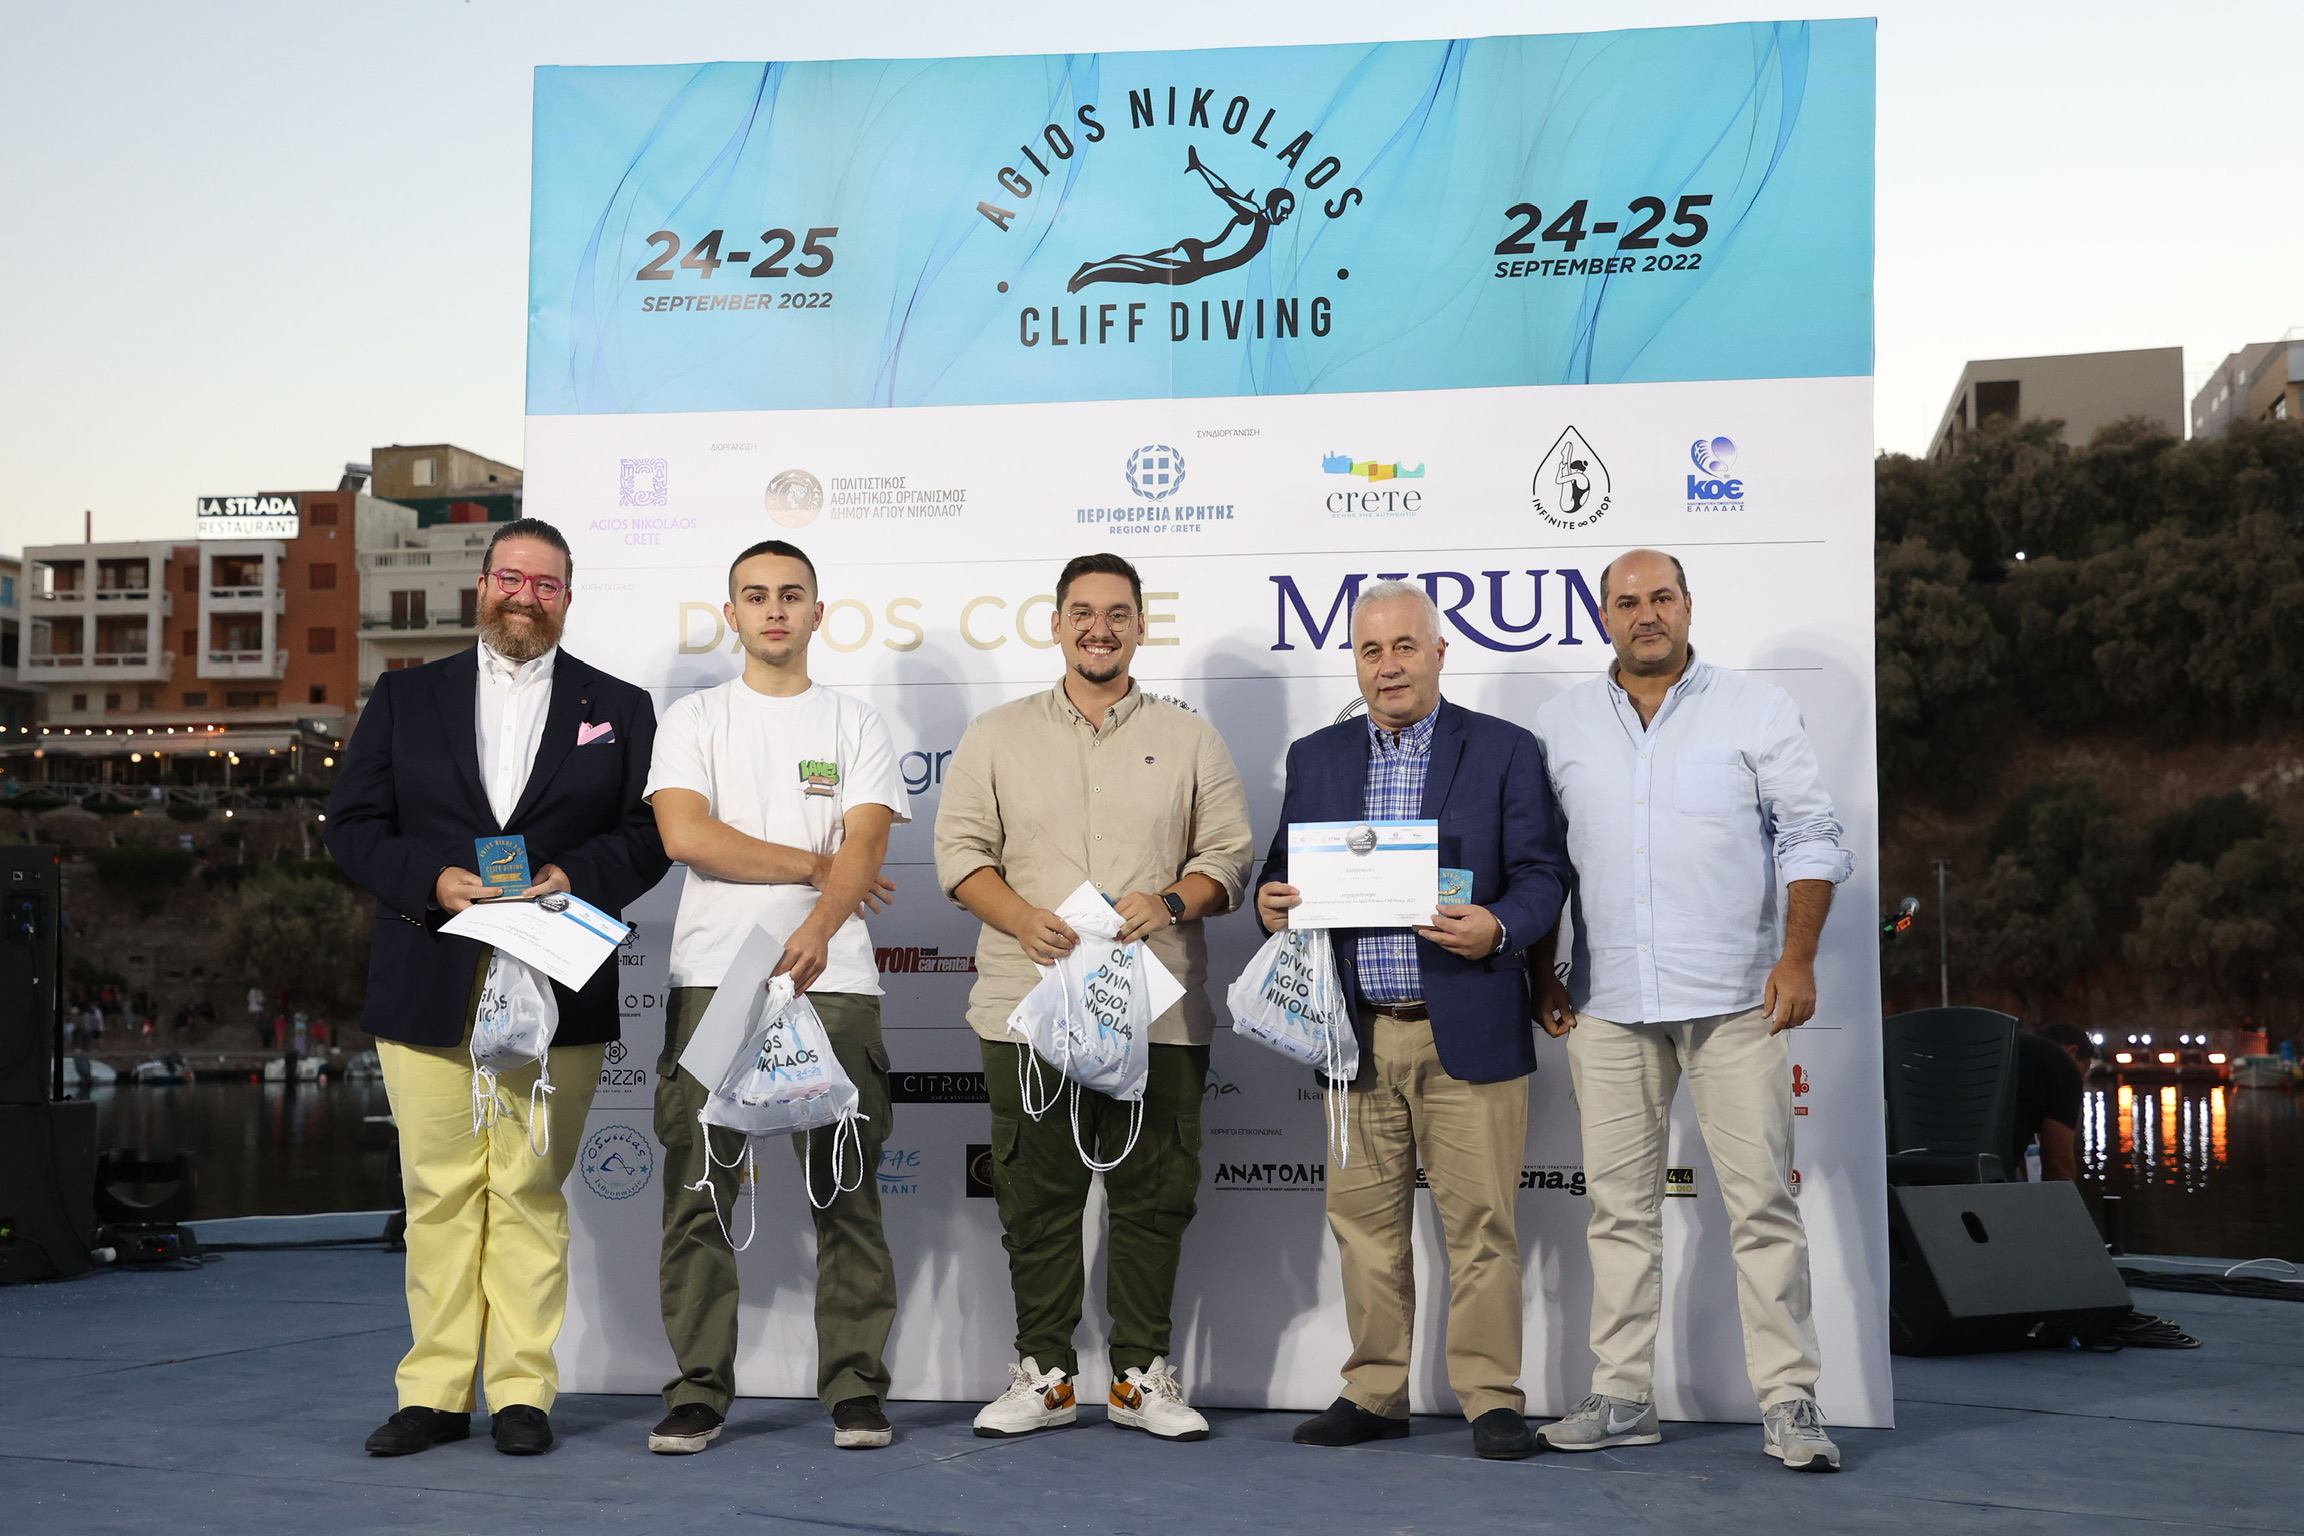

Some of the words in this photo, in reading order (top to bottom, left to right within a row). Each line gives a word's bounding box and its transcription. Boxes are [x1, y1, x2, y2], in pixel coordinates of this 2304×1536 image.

[976, 104, 1105, 232] AGIOS
[1129, 86, 1363, 219] NIKOLAOS
[1494, 194, 1714, 255] 24-25
[636, 227, 839, 281] 24-25
[1494, 256, 1636, 279] SEPTEMBER
[1642, 252, 1702, 272] 2022
[641, 294, 772, 314] SEPTEMBER
[777, 291, 833, 310] 2022
[1020, 302, 1147, 347] CLIFF
[1170, 296, 1332, 342] DIVING
[199, 498, 223, 516] LA
[225, 496, 297, 516] STRADA
[1532, 498, 1575, 530] INFINITE
[1588, 496, 1612, 523] DROP
[199, 521, 295, 535] RESTAURANT
[589, 518, 629, 531] AGIOS
[632, 518, 697, 530] NIKOLAOS
[1109, 525, 1150, 534] REGION
[1153, 525, 1168, 533] OF
[624, 533, 661, 546] CRETE
[1269, 568, 1615, 653] MRUM
[679, 598, 924, 655] DOS
[960, 591, 1180, 651] COE
[599, 1069, 646, 1086] AZZA
[903, 1075, 987, 1092] CITRON
[1519, 1171, 1587, 1196] cna.g
[1668, 1170, 1692, 1184] 4.4
